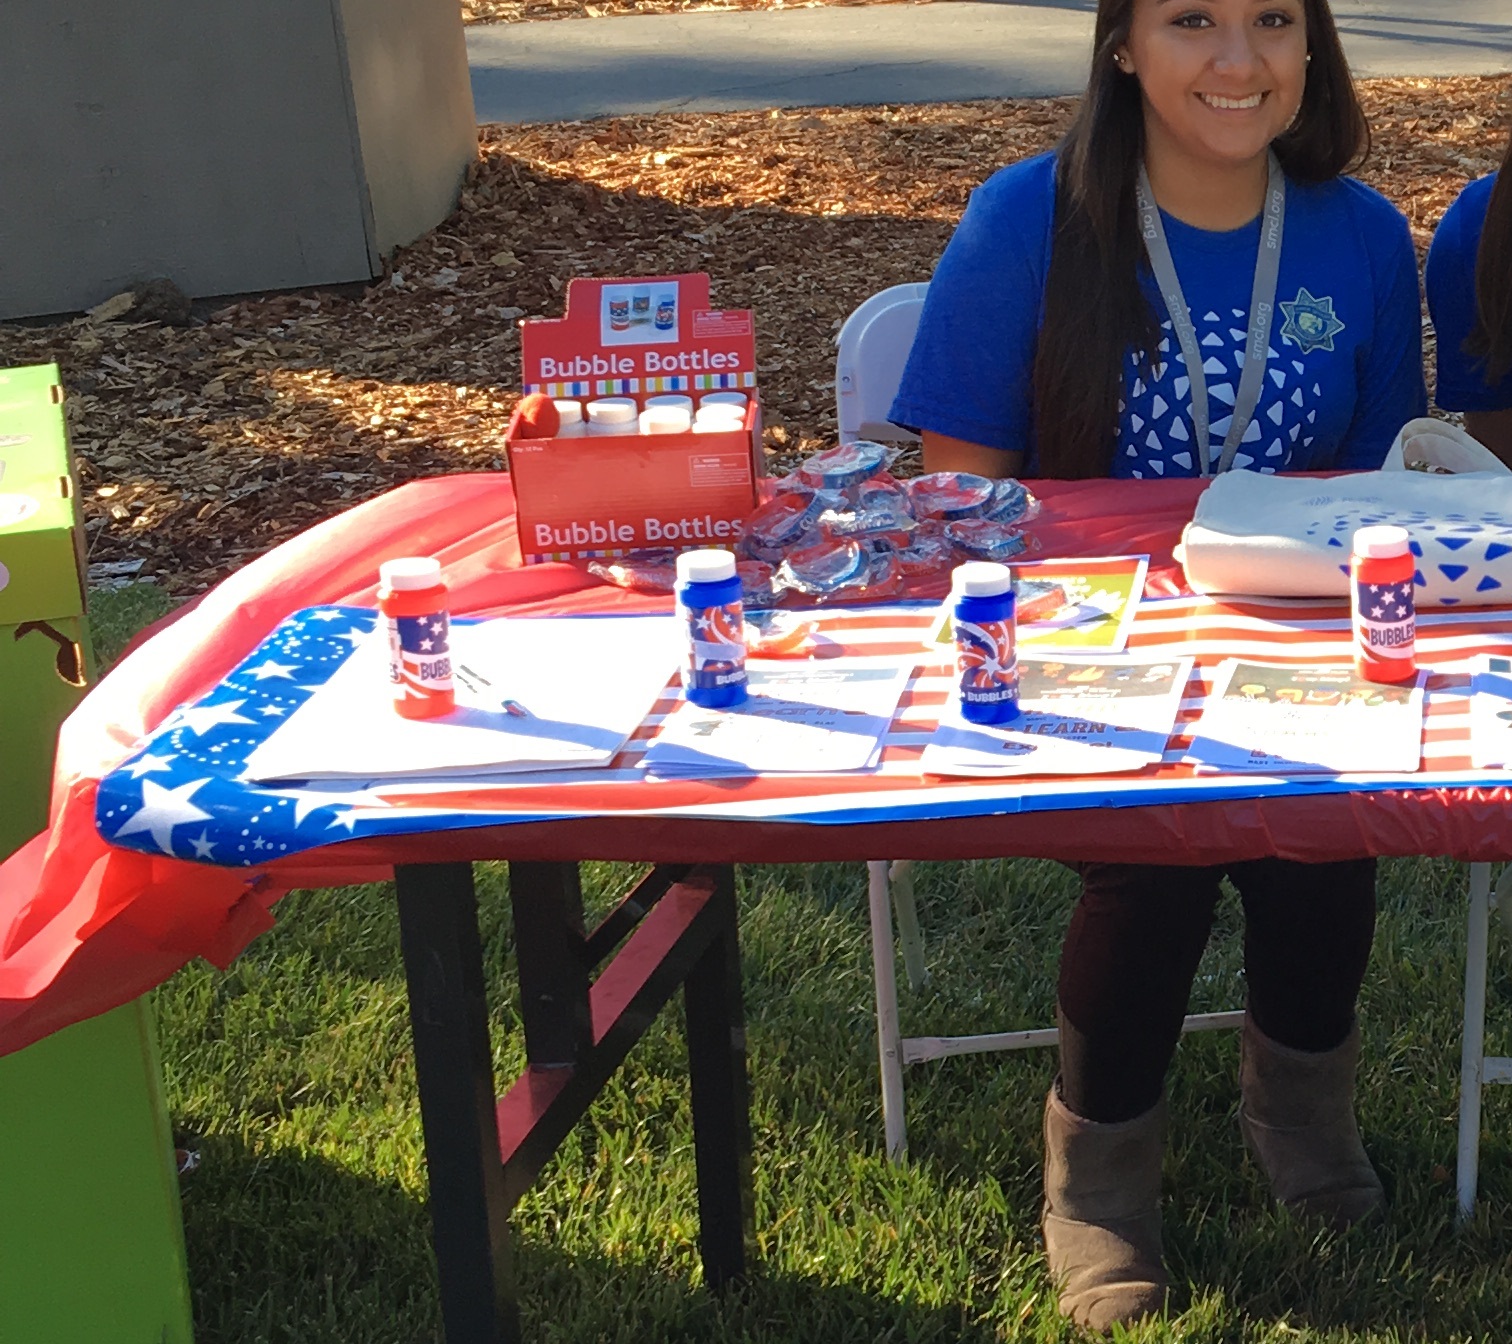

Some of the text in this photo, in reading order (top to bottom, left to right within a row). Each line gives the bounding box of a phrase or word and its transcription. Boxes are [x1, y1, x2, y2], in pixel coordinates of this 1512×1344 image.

[1267, 190, 1284, 249] smcl.org
[1252, 302, 1272, 361] smcl.org
[540, 348, 740, 378] Bubble Bottles
[535, 515, 743, 546] Bubble Bottles
[1370, 622, 1416, 647] BUBBLES
[420, 657, 452, 681] BUBB
[967, 689, 1014, 703] BUBBLES
